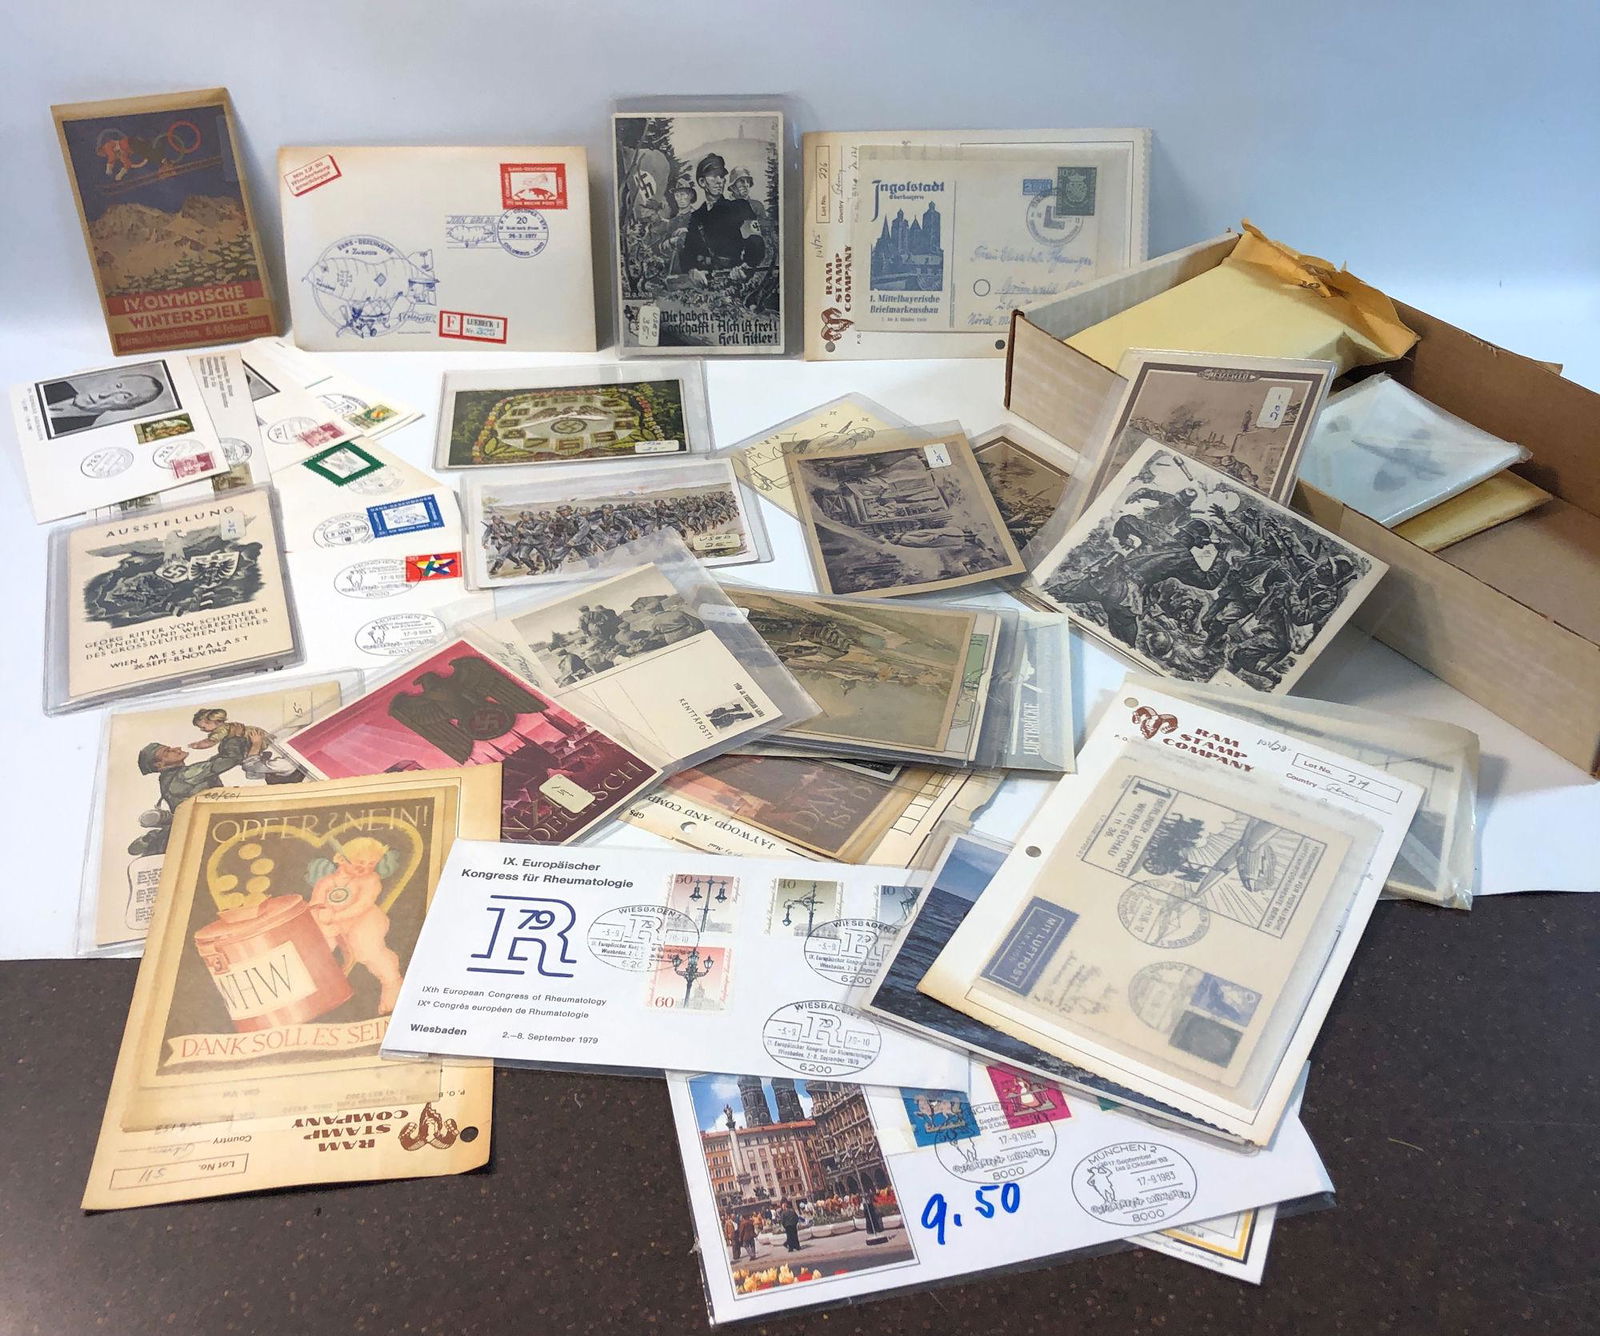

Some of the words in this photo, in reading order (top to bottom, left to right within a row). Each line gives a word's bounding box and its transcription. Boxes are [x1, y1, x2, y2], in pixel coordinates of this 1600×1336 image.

[825, 262, 833, 296] RAM
[835, 253, 843, 303] STAMP
[144, 285, 246, 309] OLYMPISCHE
[129, 302, 250, 329] WINTERSPIELE
[105, 505, 235, 539] AUSSTELLUNG
[169, 621, 195, 631] VON
[110, 658, 138, 669] WIEN
[148, 635, 250, 660] MESSEPALAST
[679, 697, 714, 740] KENTTÄPOSTI
[1022, 702, 1040, 756] LUFTBRÜCKE
[1195, 728, 1241, 749] RAM
[1162, 738, 1255, 773] COMPANY
[1180, 734, 1249, 759] STAMP
[1302, 760, 1317, 770] Lot
[1317, 765, 1333, 776] No.
[1285, 771, 1318, 789] Country
[628, 808, 646, 820] GPS
[684, 808, 714, 823] AND
[714, 819, 777, 850] JAYWOOD
[1107, 803, 1147, 857] WERBESCHAU
[503, 856, 519, 867] IX.
[521, 858, 601, 873] Europäischer
[461, 868, 520, 882] Kongress
[522, 873, 541, 883] für
[543, 874, 635, 889] Rheumatologie
[675, 874, 694, 886] 50
[882, 885, 896, 896] 10
[1041, 916, 1057, 935] MIT
[1012, 935, 1044, 983] LUFTPOST
[840, 975, 873, 985] 6200
[422, 985, 441, 994] IXth
[442, 987, 485, 998] European
[487, 990, 530, 1002] Congress
[531, 993, 542, 1001] of
[544, 994, 608, 1007] Rheumatology
[654, 996, 675, 1009] 60
[432, 1000, 470, 1012] Congrès
[471, 1003, 514, 1016] européen
[515, 1007, 527, 1015] de
[528, 1008, 590, 1020] Rhumatologie
[794, 1001, 855, 1017] WIESBADEN
[410, 1023, 468, 1037] Wiesbaden
[527, 1033, 577, 1045] September
[578, 1036, 600, 1045] 1979
[180, 1035, 249, 1059] DANK
[252, 1026, 308, 1053] SOLL
[312, 1026, 339, 1047] ES
[799, 1063, 833, 1074] 6200
[291, 1109, 410, 1130] COMPANY
[212, 1134, 253, 1145] Country
[303, 1123, 392, 1141] STAMP
[318, 1138, 377, 1153] RAM
[1088, 1143, 1148, 1166] MÜNCHEN
[219, 1160, 236, 1169] Lot
[991, 1166, 1026, 1181] 8000
[921, 1182, 1021, 1246] 9.50
[1131, 1208, 1166, 1223] 8000
